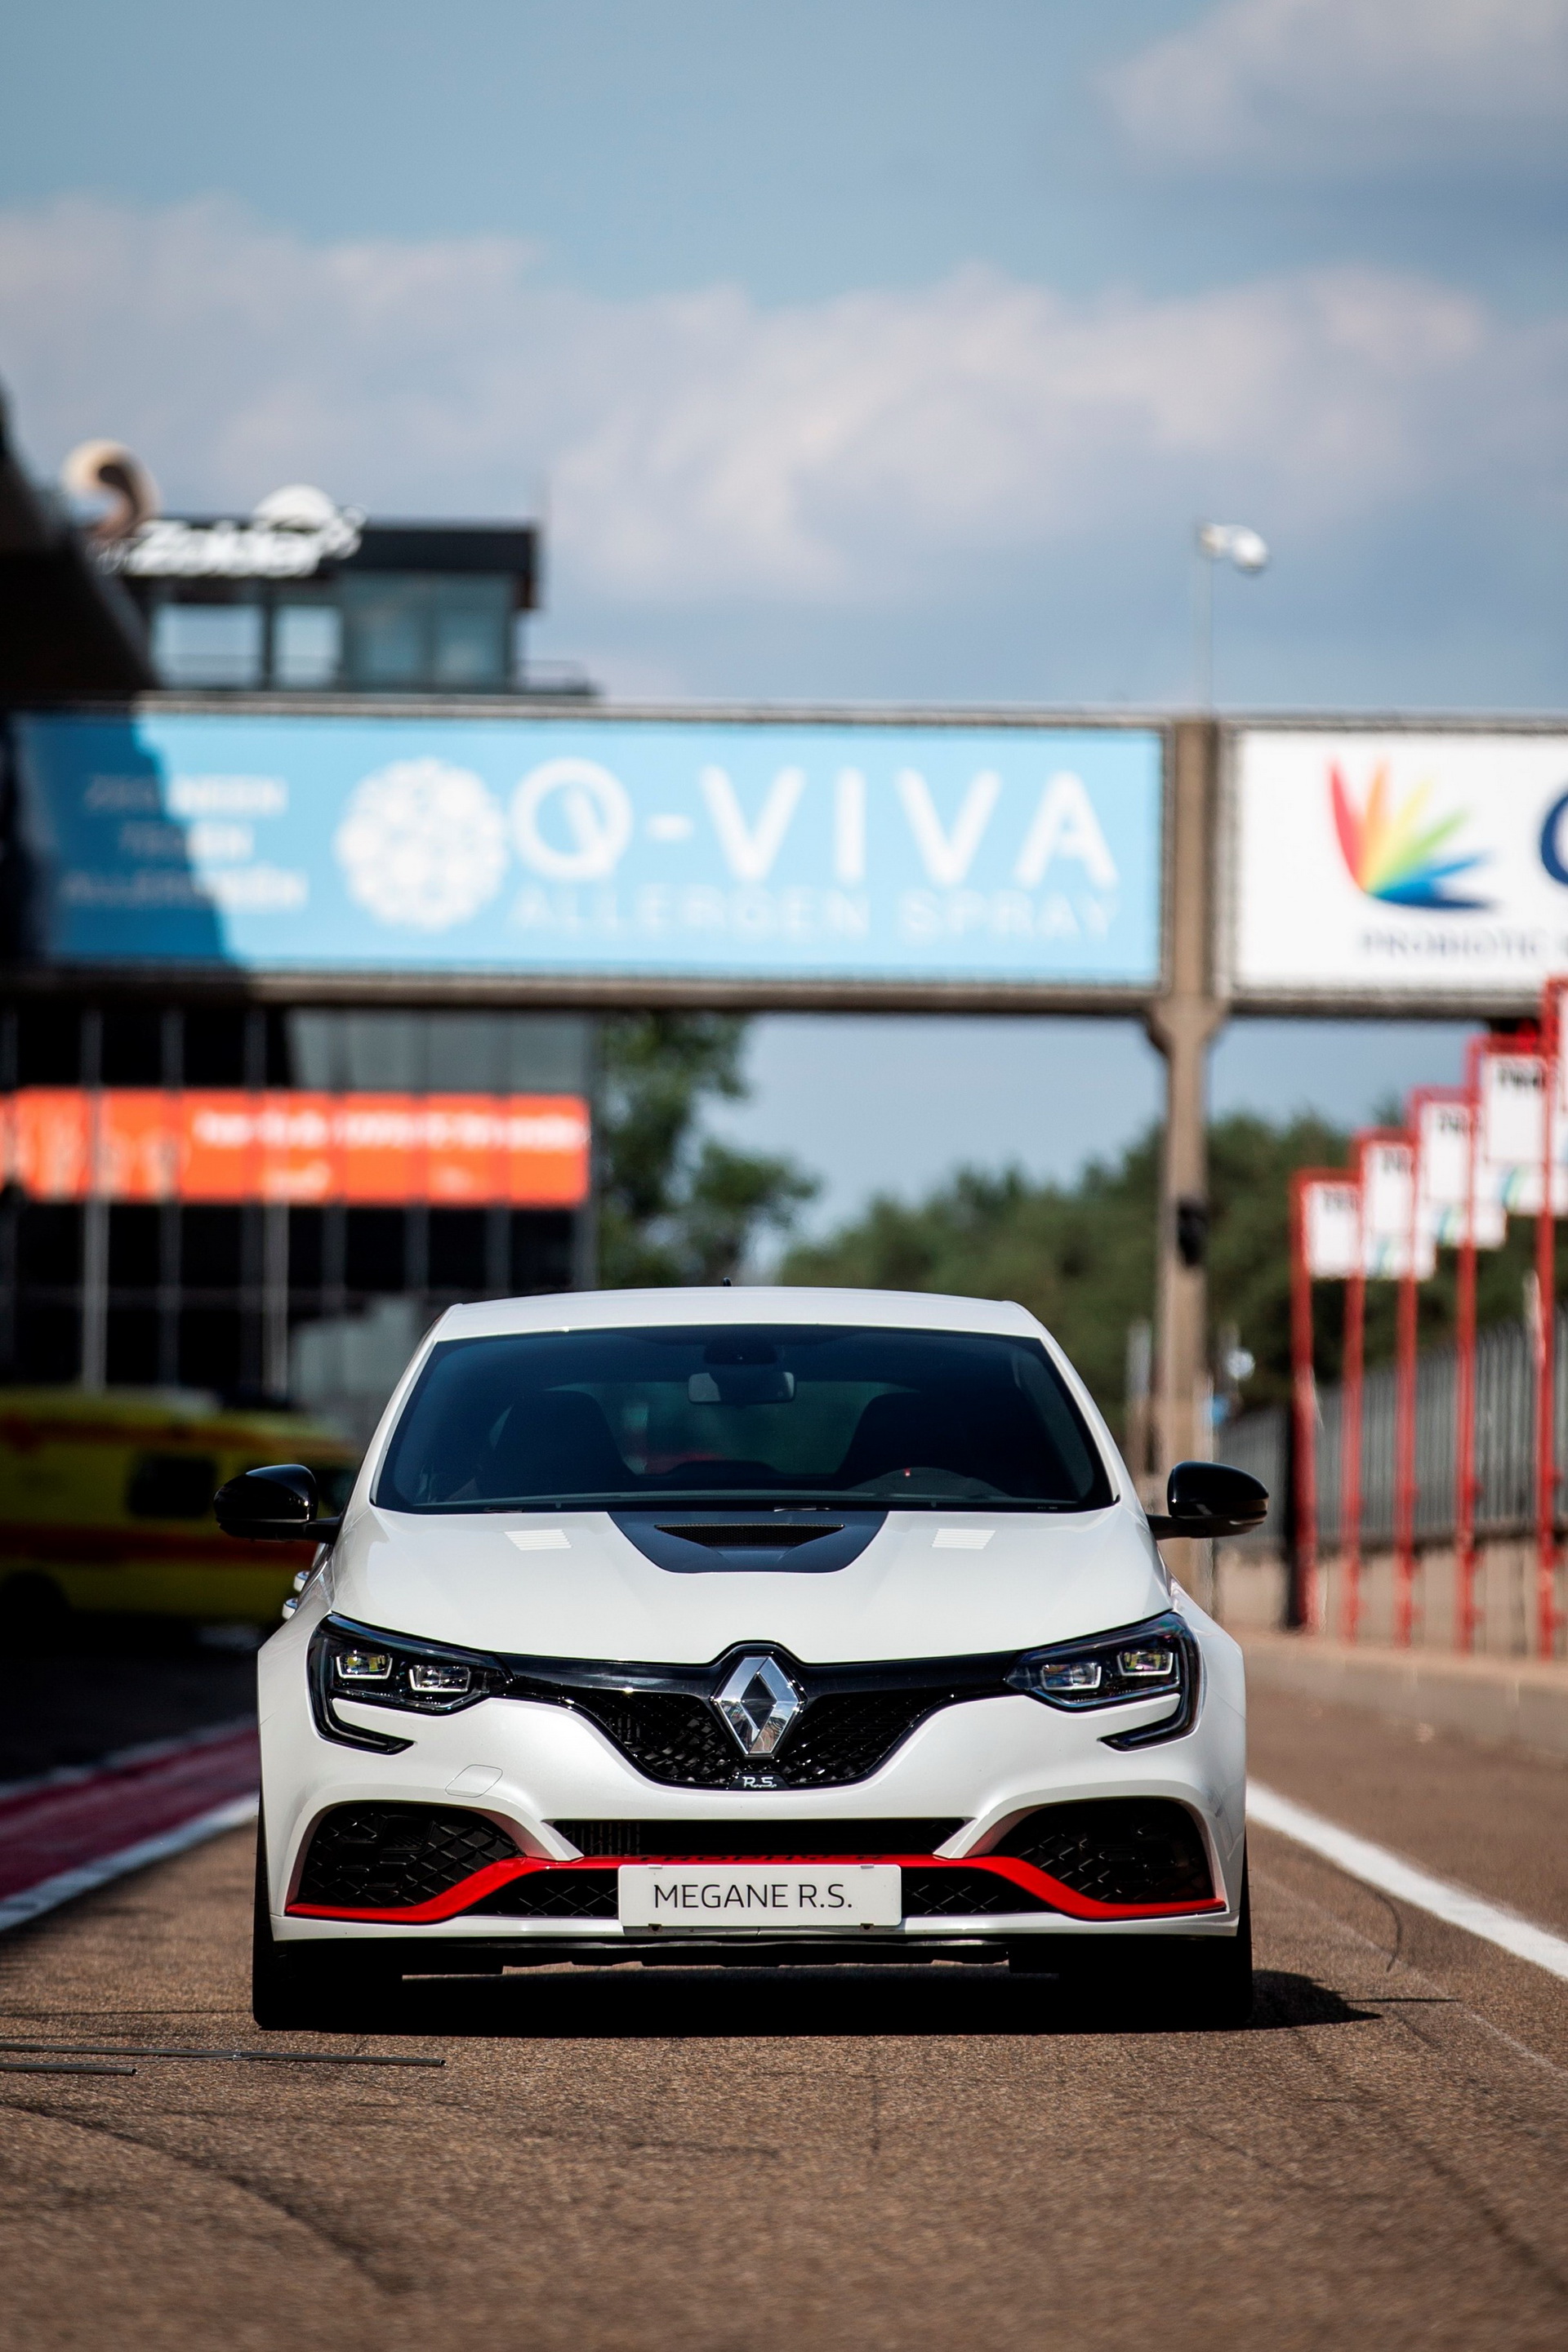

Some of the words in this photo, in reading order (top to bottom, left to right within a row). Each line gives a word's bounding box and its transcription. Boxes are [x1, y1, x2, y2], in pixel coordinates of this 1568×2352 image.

[508, 757, 1119, 888] Q-VIVA
[508, 884, 872, 939] ALLERGEN
[898, 890, 1117, 946] SPRAY
[653, 1883, 789, 1909] MEGANE
[798, 1883, 853, 1909] R.S.
